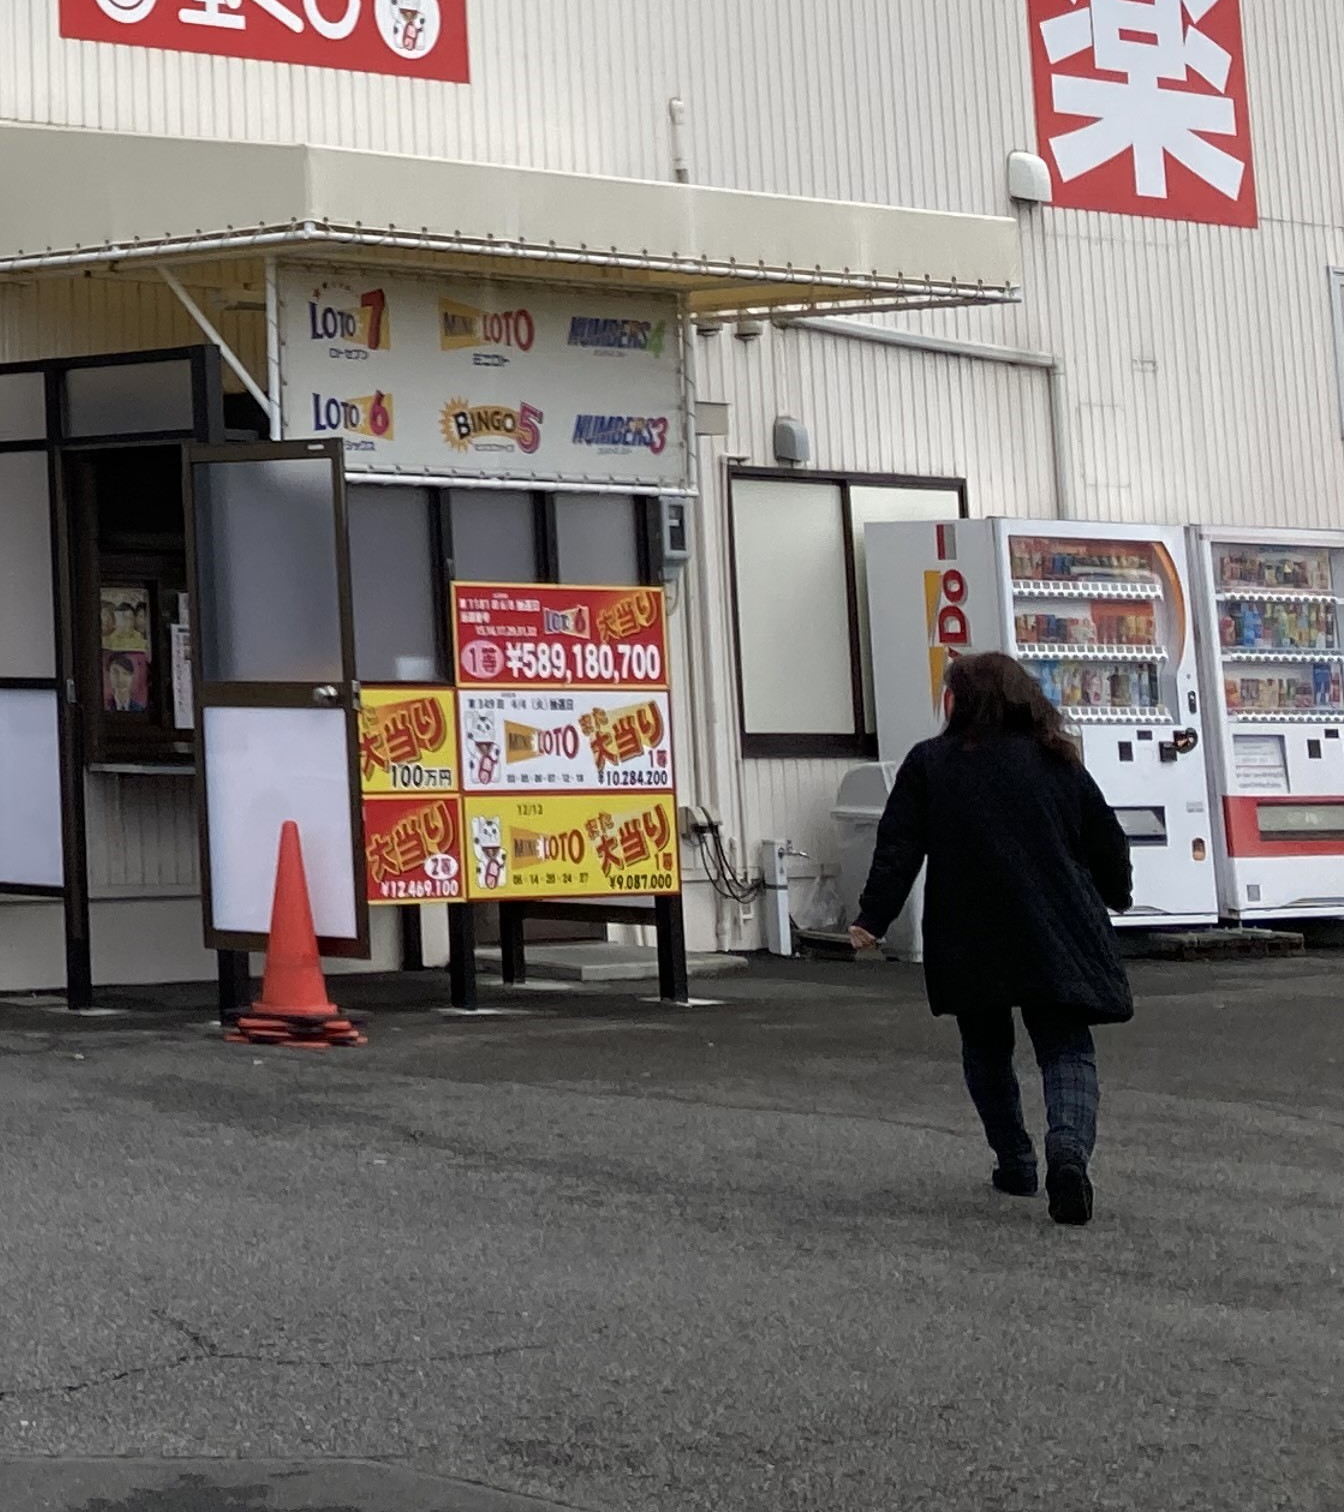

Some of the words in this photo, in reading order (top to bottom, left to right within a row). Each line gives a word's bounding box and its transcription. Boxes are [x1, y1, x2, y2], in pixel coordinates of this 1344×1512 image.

[595, 591, 657, 643] 大当り
[505, 641, 662, 684] ¥589,180,700
[359, 697, 446, 782] 大当り
[590, 699, 665, 773] 大当り
[391, 764, 453, 788] 100万円
[365, 800, 455, 884] 大当り
[595, 803, 671, 877] 大当り
